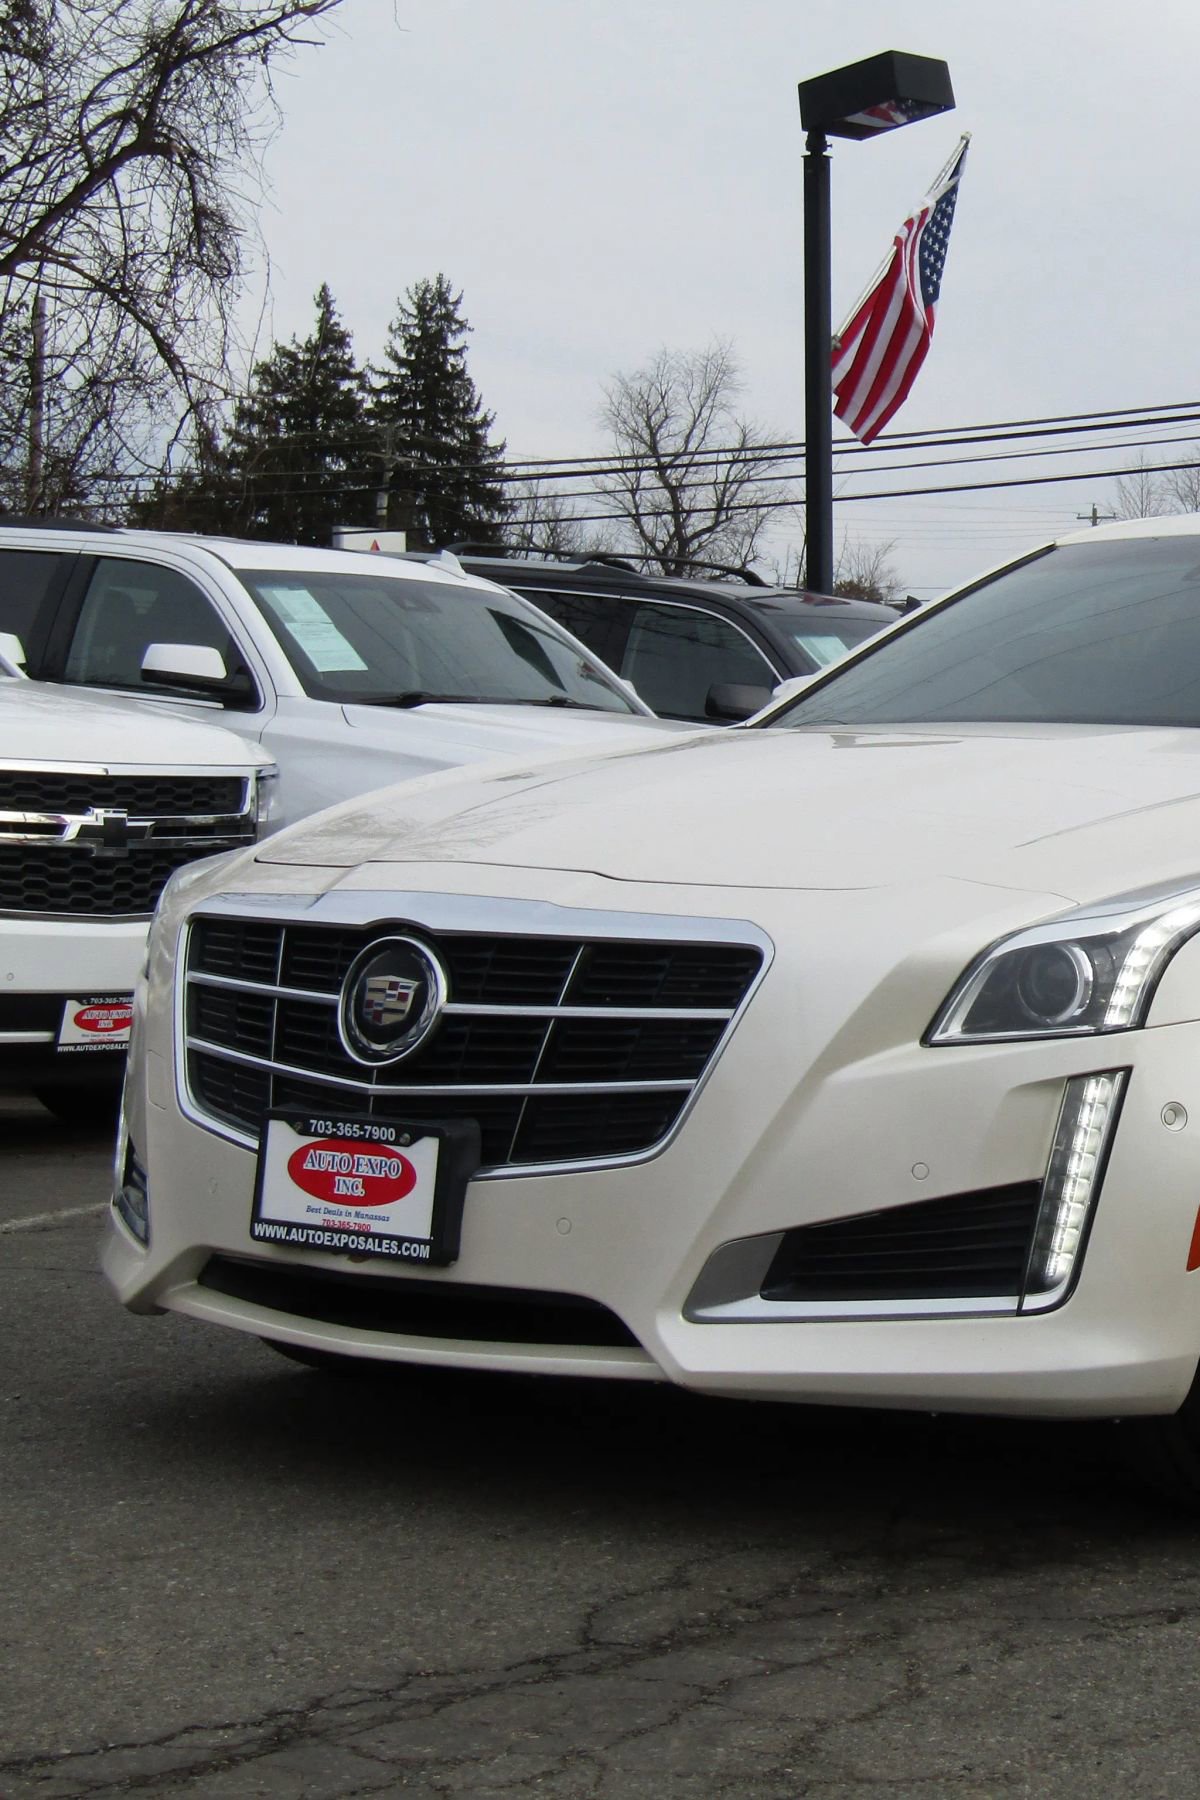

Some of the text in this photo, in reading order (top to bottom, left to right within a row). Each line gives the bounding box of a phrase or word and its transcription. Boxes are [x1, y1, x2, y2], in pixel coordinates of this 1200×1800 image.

[309, 1119, 396, 1142] 703-365-7900
[304, 1150, 402, 1178] AUTO EXPO
[334, 1176, 366, 1197] INC.
[306, 1205, 390, 1223] Best Deals in Manassas
[322, 1218, 371, 1232] 703-365-7900
[254, 1222, 430, 1259] WWW.AUTOEXPOSALES.COM
